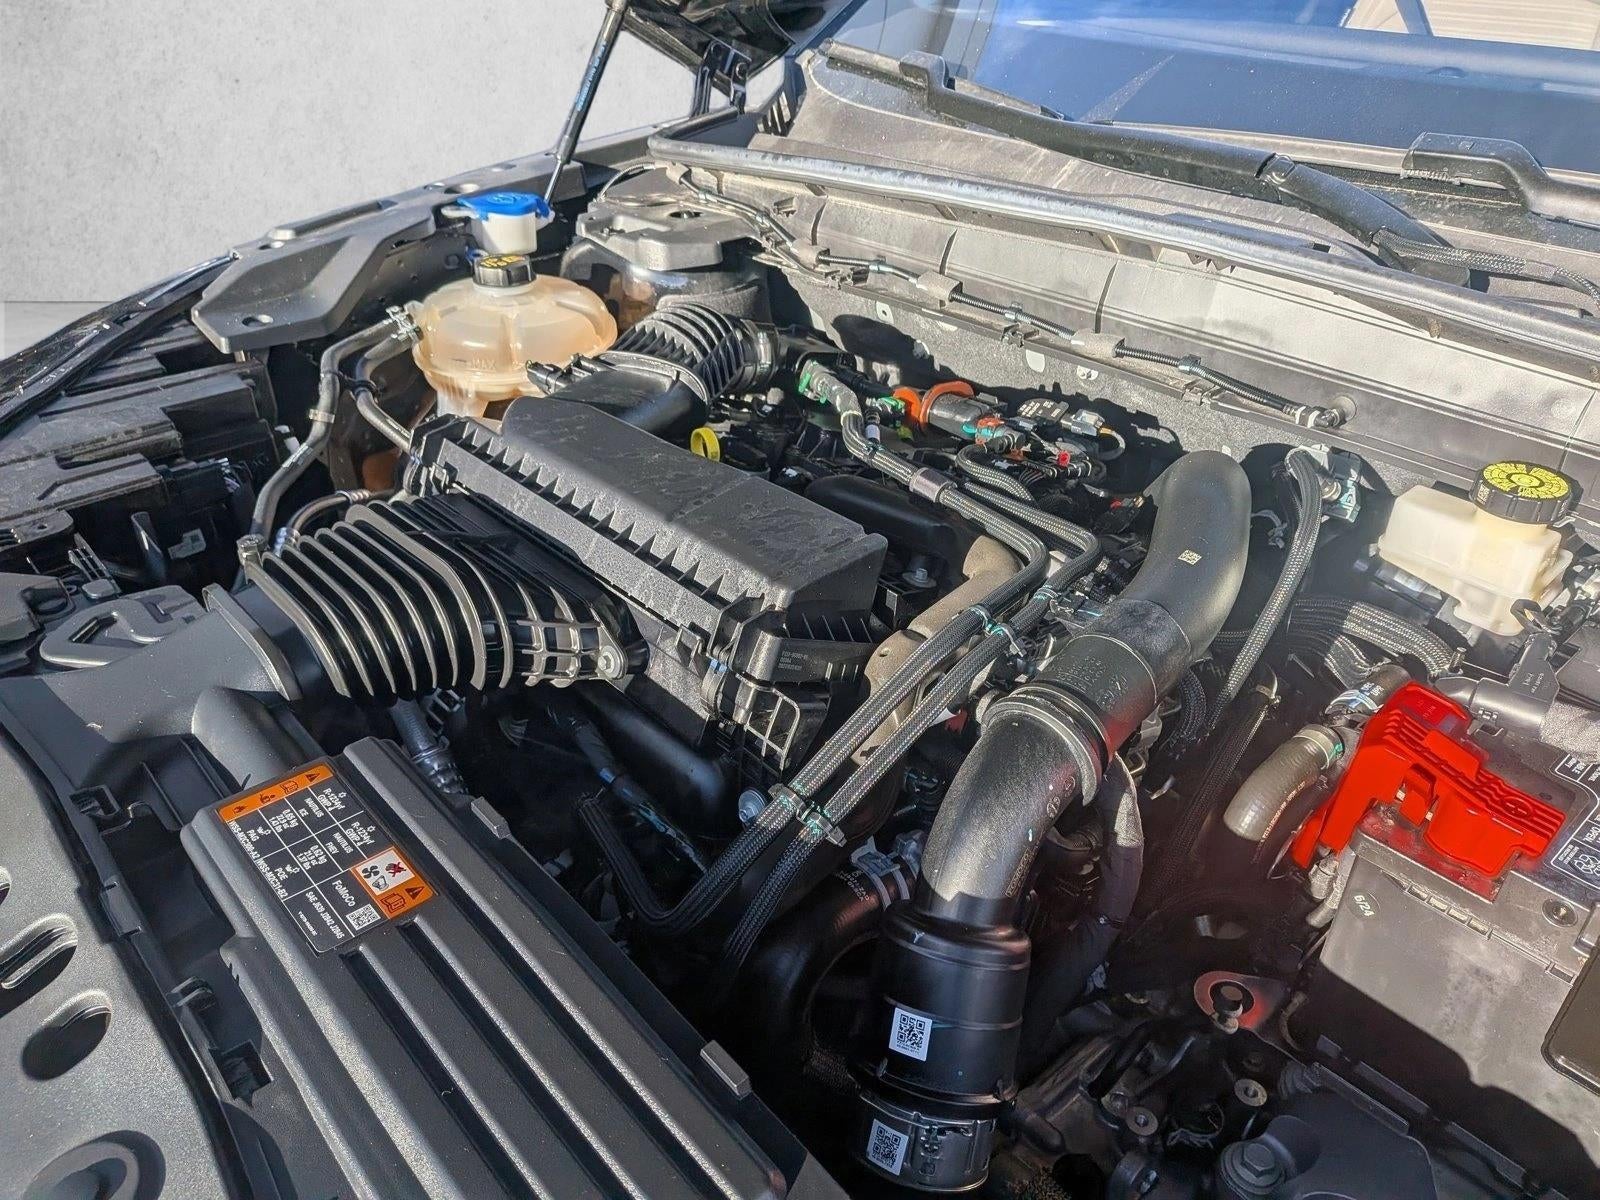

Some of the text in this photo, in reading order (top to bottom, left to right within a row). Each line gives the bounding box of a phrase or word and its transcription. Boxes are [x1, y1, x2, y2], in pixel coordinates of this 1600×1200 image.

[304, 796, 324, 817] NAUTILUS
[317, 794, 330, 808] GWP
[323, 788, 344, 810] R-1234yf
[298, 808, 308, 816] ICE
[246, 829, 259, 841] PAG
[332, 831, 353, 853] NAUTILUS
[345, 827, 360, 842] GWP
[350, 821, 374, 846] R-1234yf
[273, 867, 287, 880] POE
[305, 891, 317, 902] SAE
[331, 879, 357, 907] FoMoCo
[1354, 895, 1375, 916] 6/24
